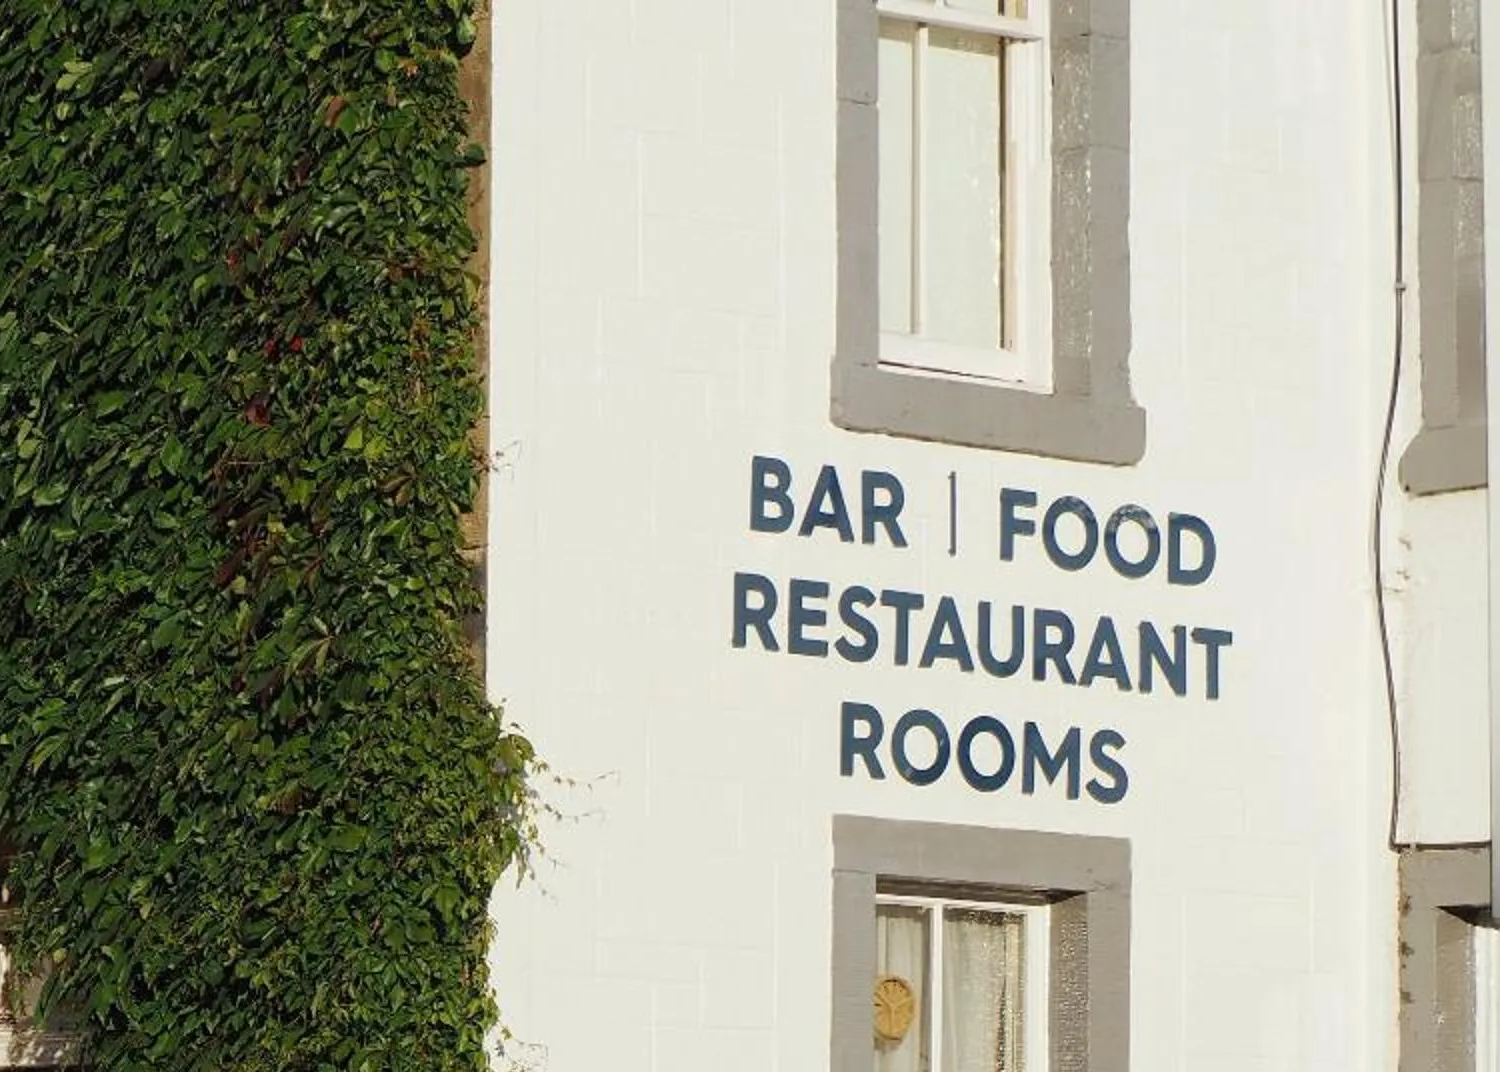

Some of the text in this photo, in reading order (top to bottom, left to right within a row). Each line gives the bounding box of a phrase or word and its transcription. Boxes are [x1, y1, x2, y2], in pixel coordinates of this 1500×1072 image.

[749, 455, 1217, 586] BAR FOOD
[731, 571, 1233, 701] RESTAURANT
[840, 701, 1129, 805] ROOMS
